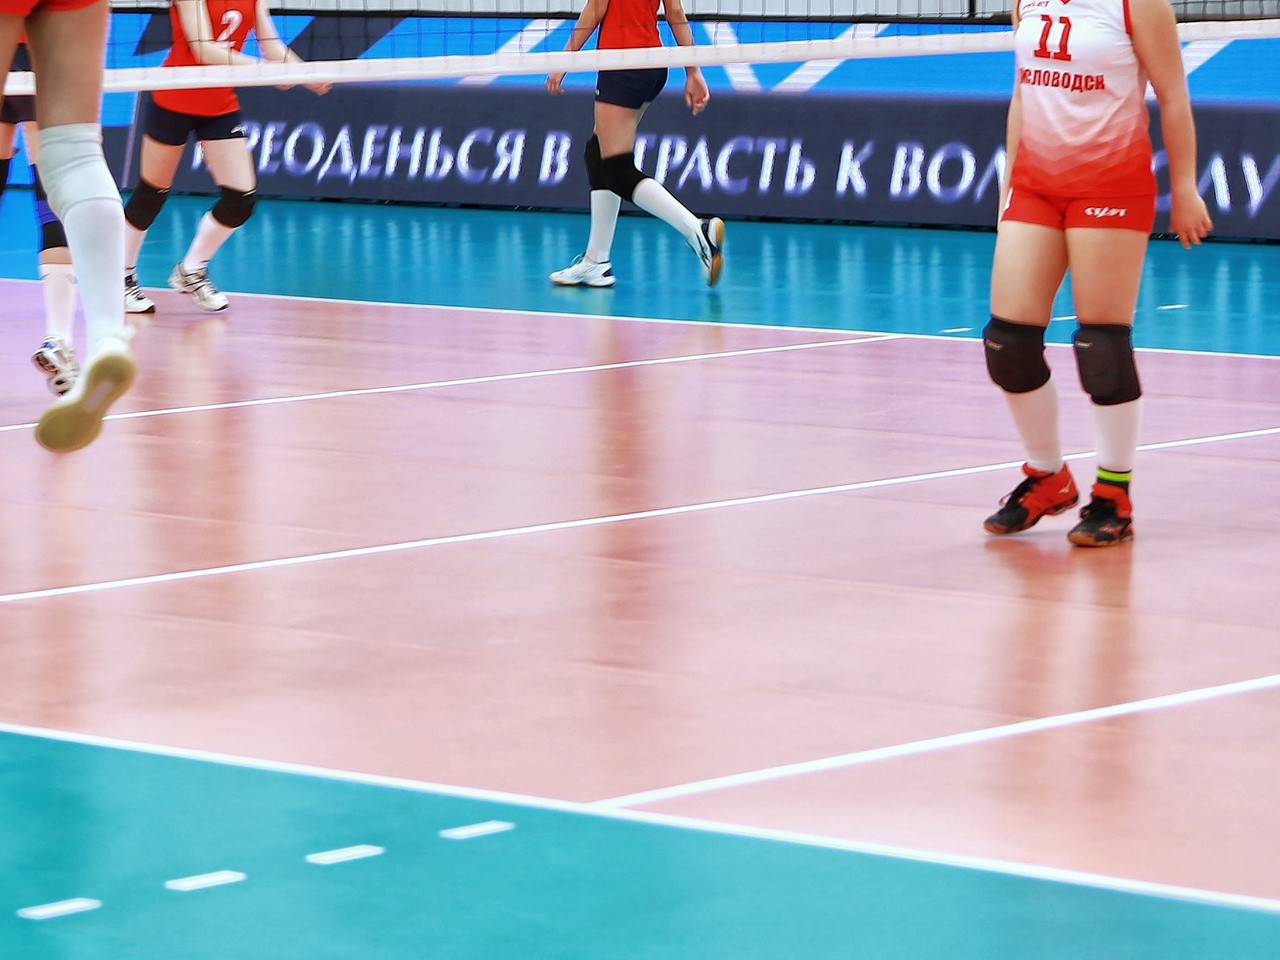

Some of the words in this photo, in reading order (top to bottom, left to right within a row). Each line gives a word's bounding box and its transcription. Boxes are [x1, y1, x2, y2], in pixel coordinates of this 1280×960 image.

[217, 9, 244, 48] 2
[1034, 14, 1072, 62] 11
[536, 131, 572, 187] В
[833, 141, 874, 198] К
